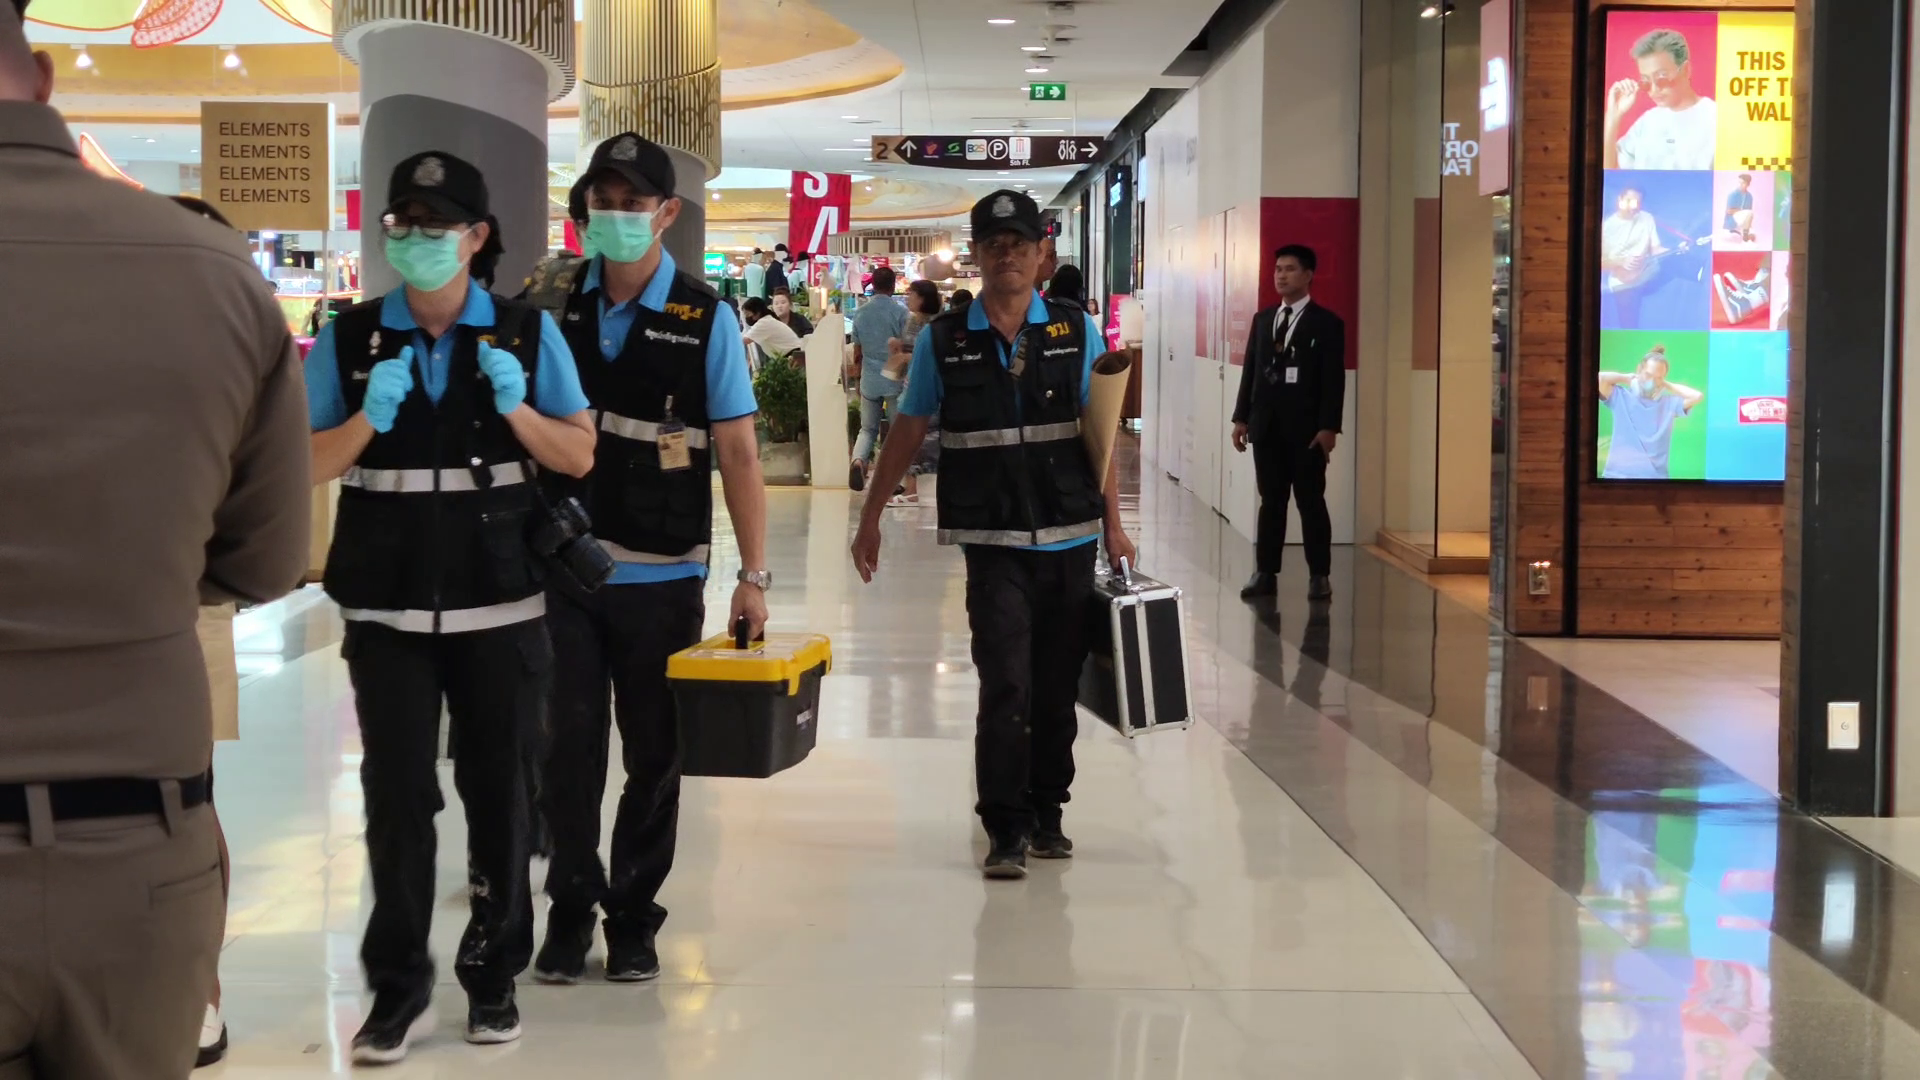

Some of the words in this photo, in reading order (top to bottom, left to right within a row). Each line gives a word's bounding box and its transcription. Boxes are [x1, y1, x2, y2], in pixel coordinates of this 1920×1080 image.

[1736, 51, 1786, 71] THIS
[1729, 76, 1770, 97] OFF
[1776, 77, 1793, 97] T
[219, 121, 311, 137] ELEMENTS
[219, 143, 311, 160] ELEMENTS
[219, 166, 311, 181] ELEMENTS
[219, 188, 311, 204] ELEMENTS
